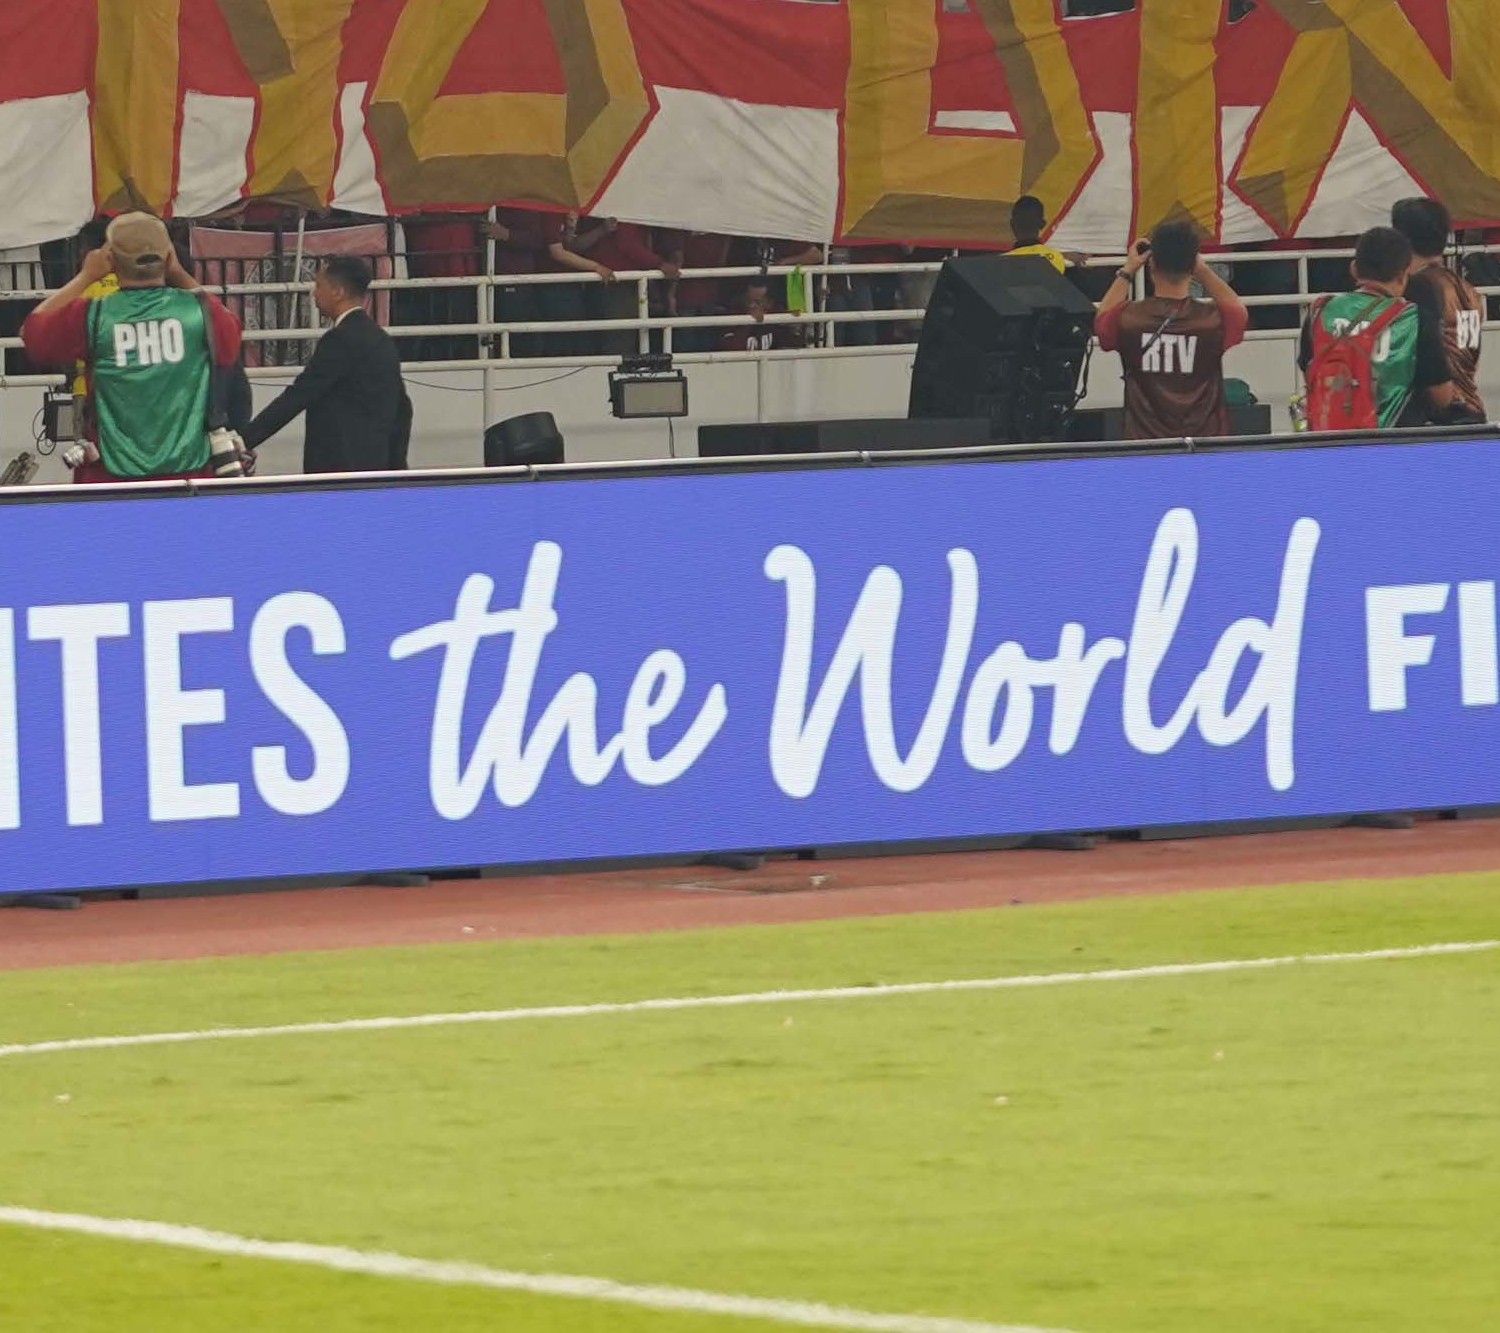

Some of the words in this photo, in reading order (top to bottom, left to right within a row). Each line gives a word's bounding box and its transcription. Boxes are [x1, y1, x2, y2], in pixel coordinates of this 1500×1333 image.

[112, 319, 186, 368] PHO
[1140, 332, 1197, 374] RTV
[389, 540, 727, 821] the
[763, 507, 1322, 798] World
